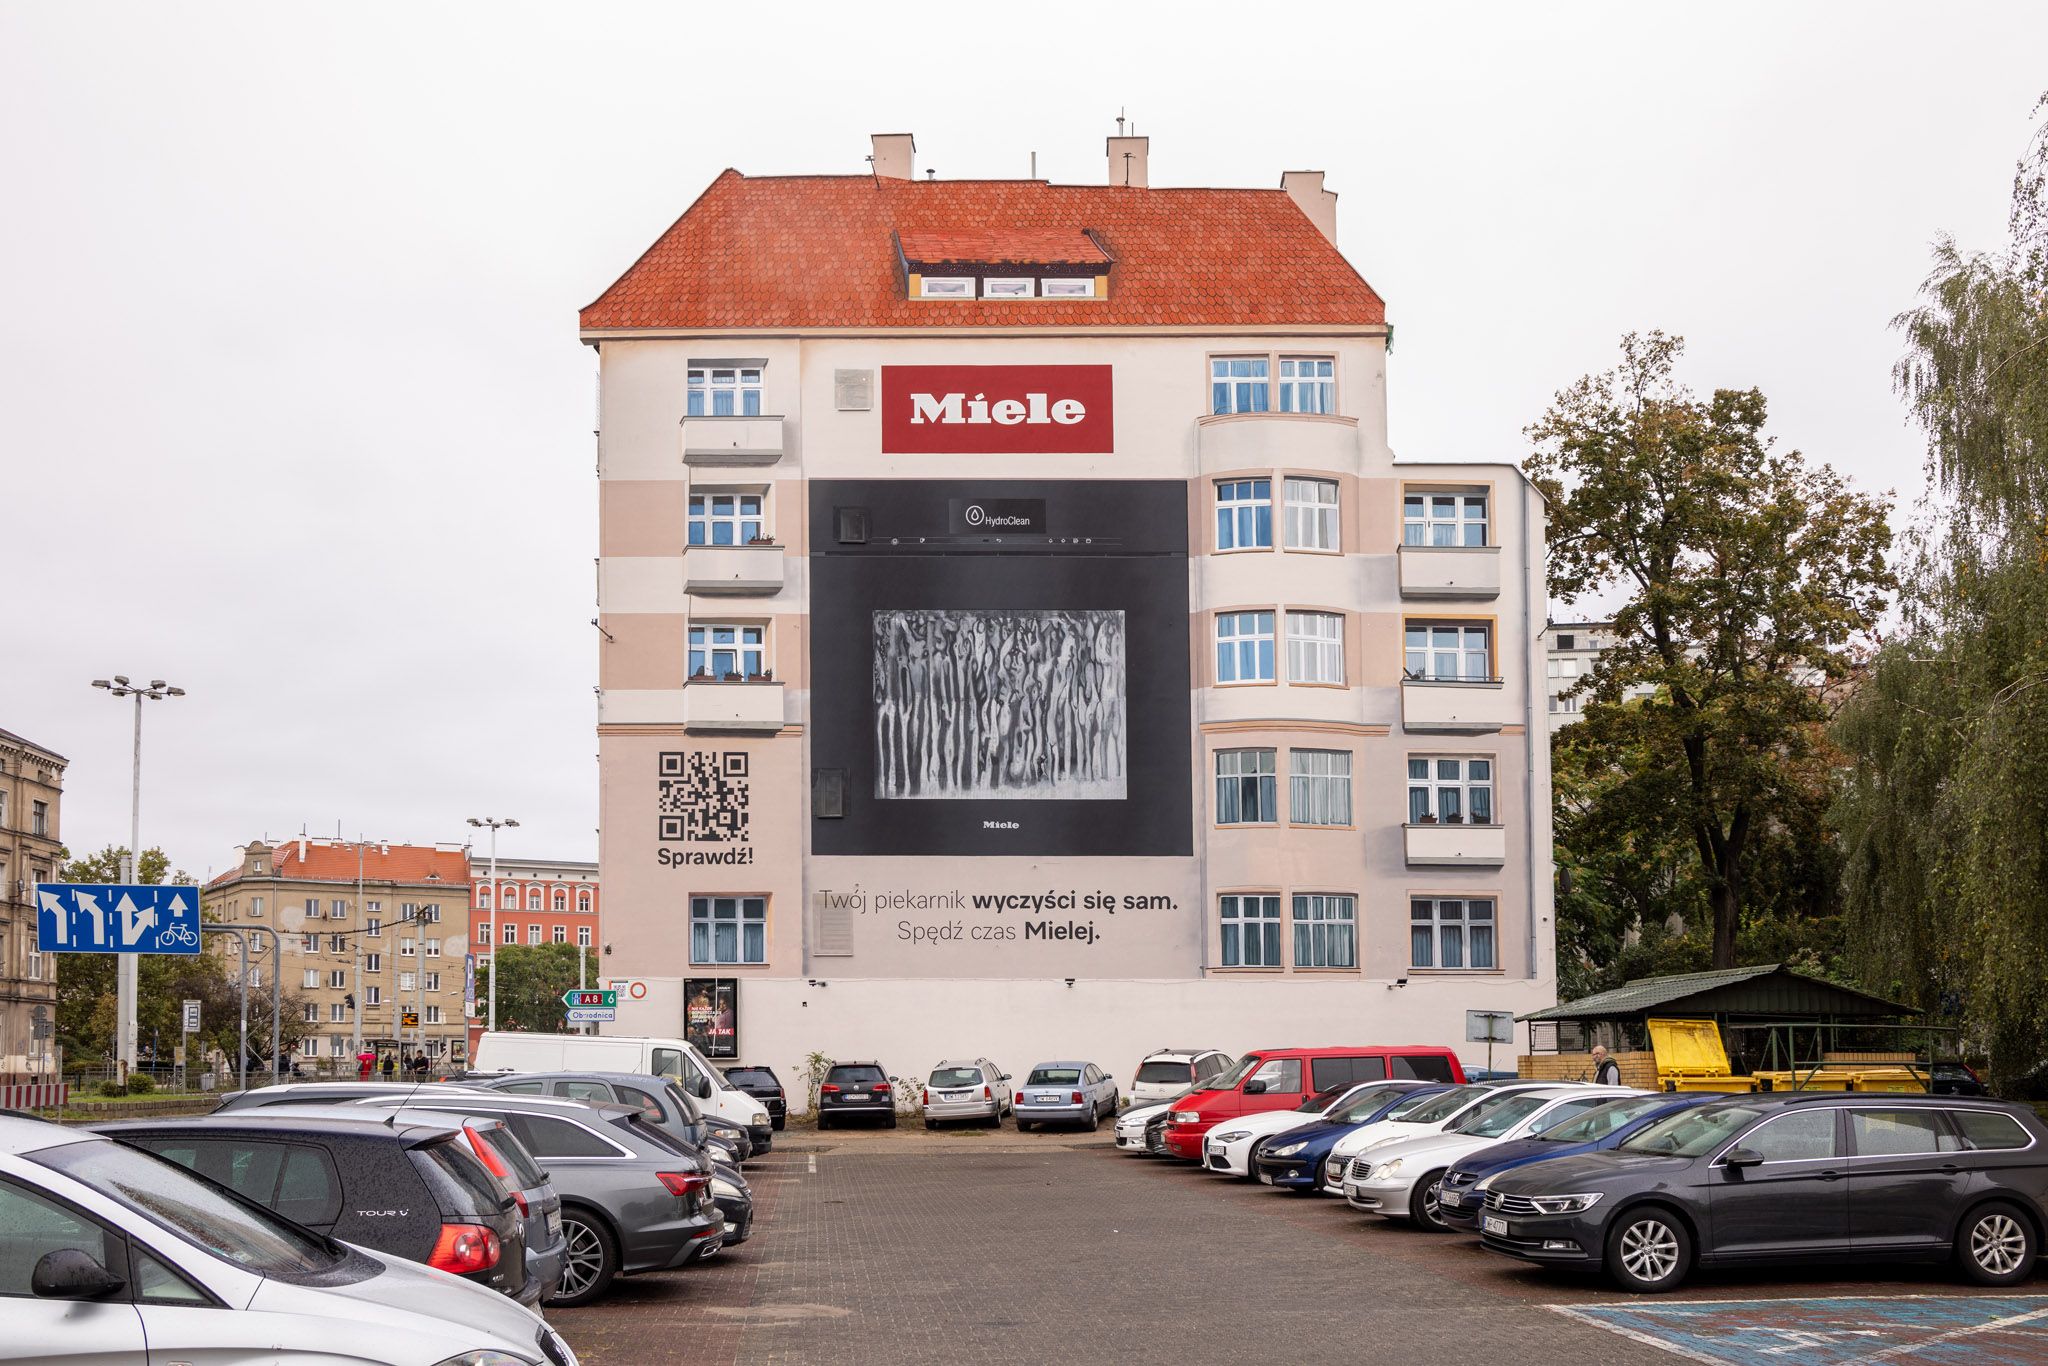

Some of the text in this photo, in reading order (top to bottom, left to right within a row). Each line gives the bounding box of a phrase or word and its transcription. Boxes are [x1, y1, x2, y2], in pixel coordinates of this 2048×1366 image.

[910, 392, 1086, 425] Miele
[985, 516, 1030, 527] HydroClean
[983, 821, 1020, 829] Miele
[657, 847, 754, 869] Sprawdź!
[819, 889, 1178, 914] Twój piekarnik wyczyści się sam.
[897, 920, 1100, 945] Spędź czas Mielej.
[584, 993, 614, 1004] A8 6
